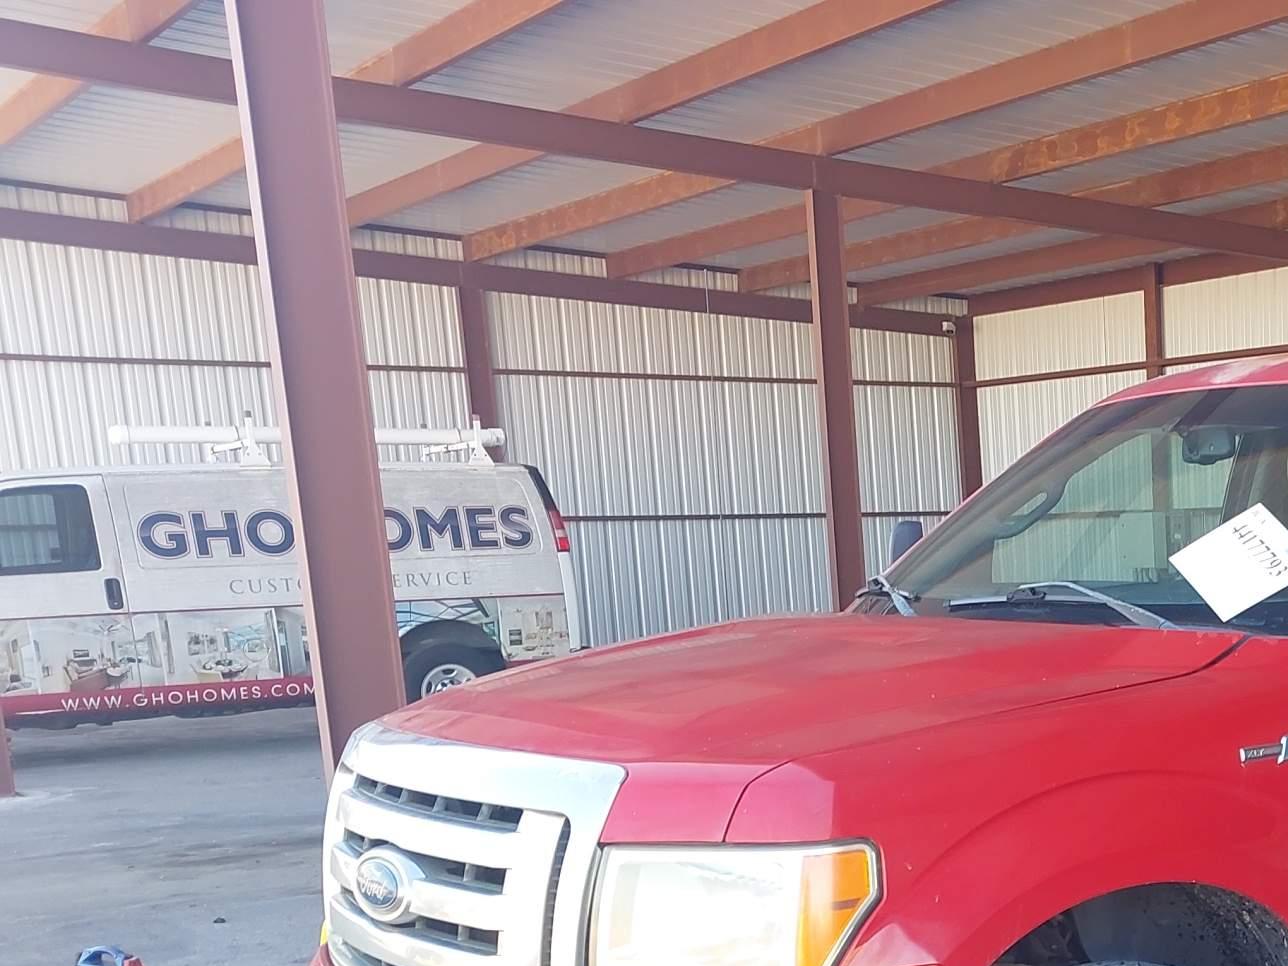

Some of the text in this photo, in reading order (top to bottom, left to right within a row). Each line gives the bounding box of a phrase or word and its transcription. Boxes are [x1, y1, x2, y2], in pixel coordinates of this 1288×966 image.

[137, 504, 534, 560] GHO OMES
[1232, 524, 1288, 577] 44177793
[229, 571, 472, 595] CUST ERVICE
